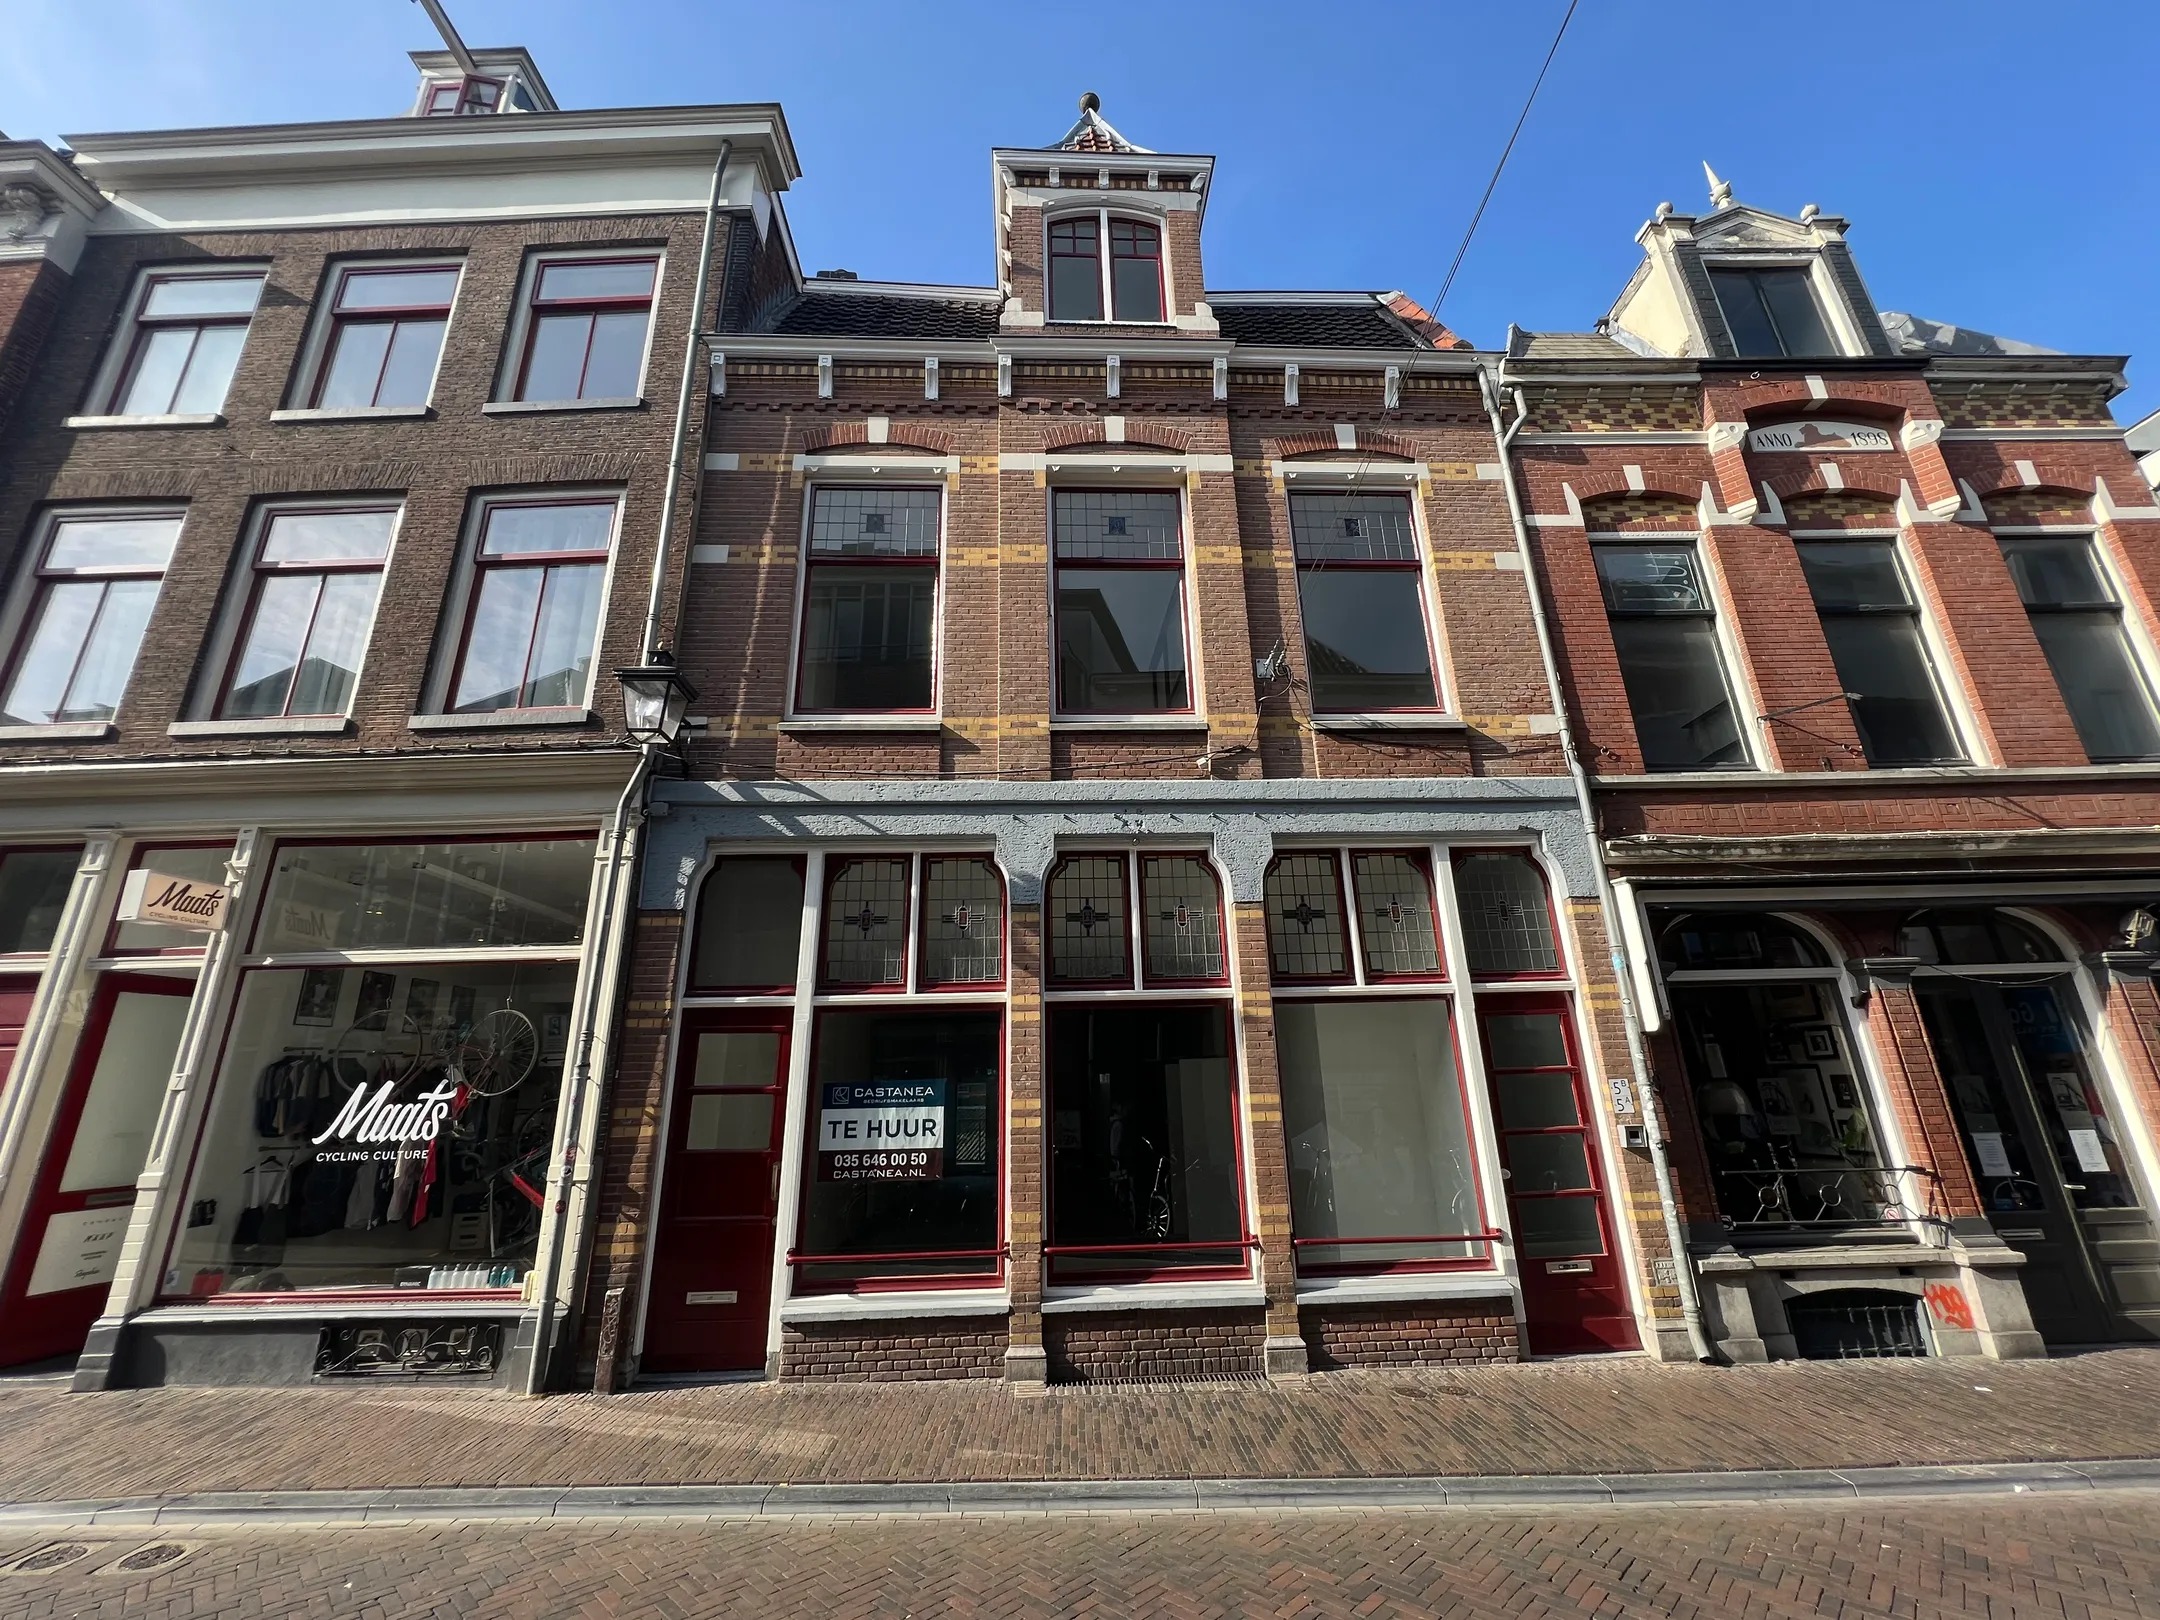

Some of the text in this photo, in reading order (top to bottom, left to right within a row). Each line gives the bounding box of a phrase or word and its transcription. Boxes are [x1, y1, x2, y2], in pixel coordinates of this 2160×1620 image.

[1756, 431, 1889, 448] ANNO 1898
[147, 881, 224, 917] Maats
[149, 911, 210, 926] CYCLING CULTURE
[854, 1086, 935, 1098] CASTANEA
[311, 1079, 458, 1145] Maats
[827, 1118, 937, 1139] TE HUUR
[315, 1149, 430, 1162] CYCLING CULTURE
[834, 1152, 928, 1168] 035 646 00 50
[833, 1168, 927, 1179] CASTANEA.NL
